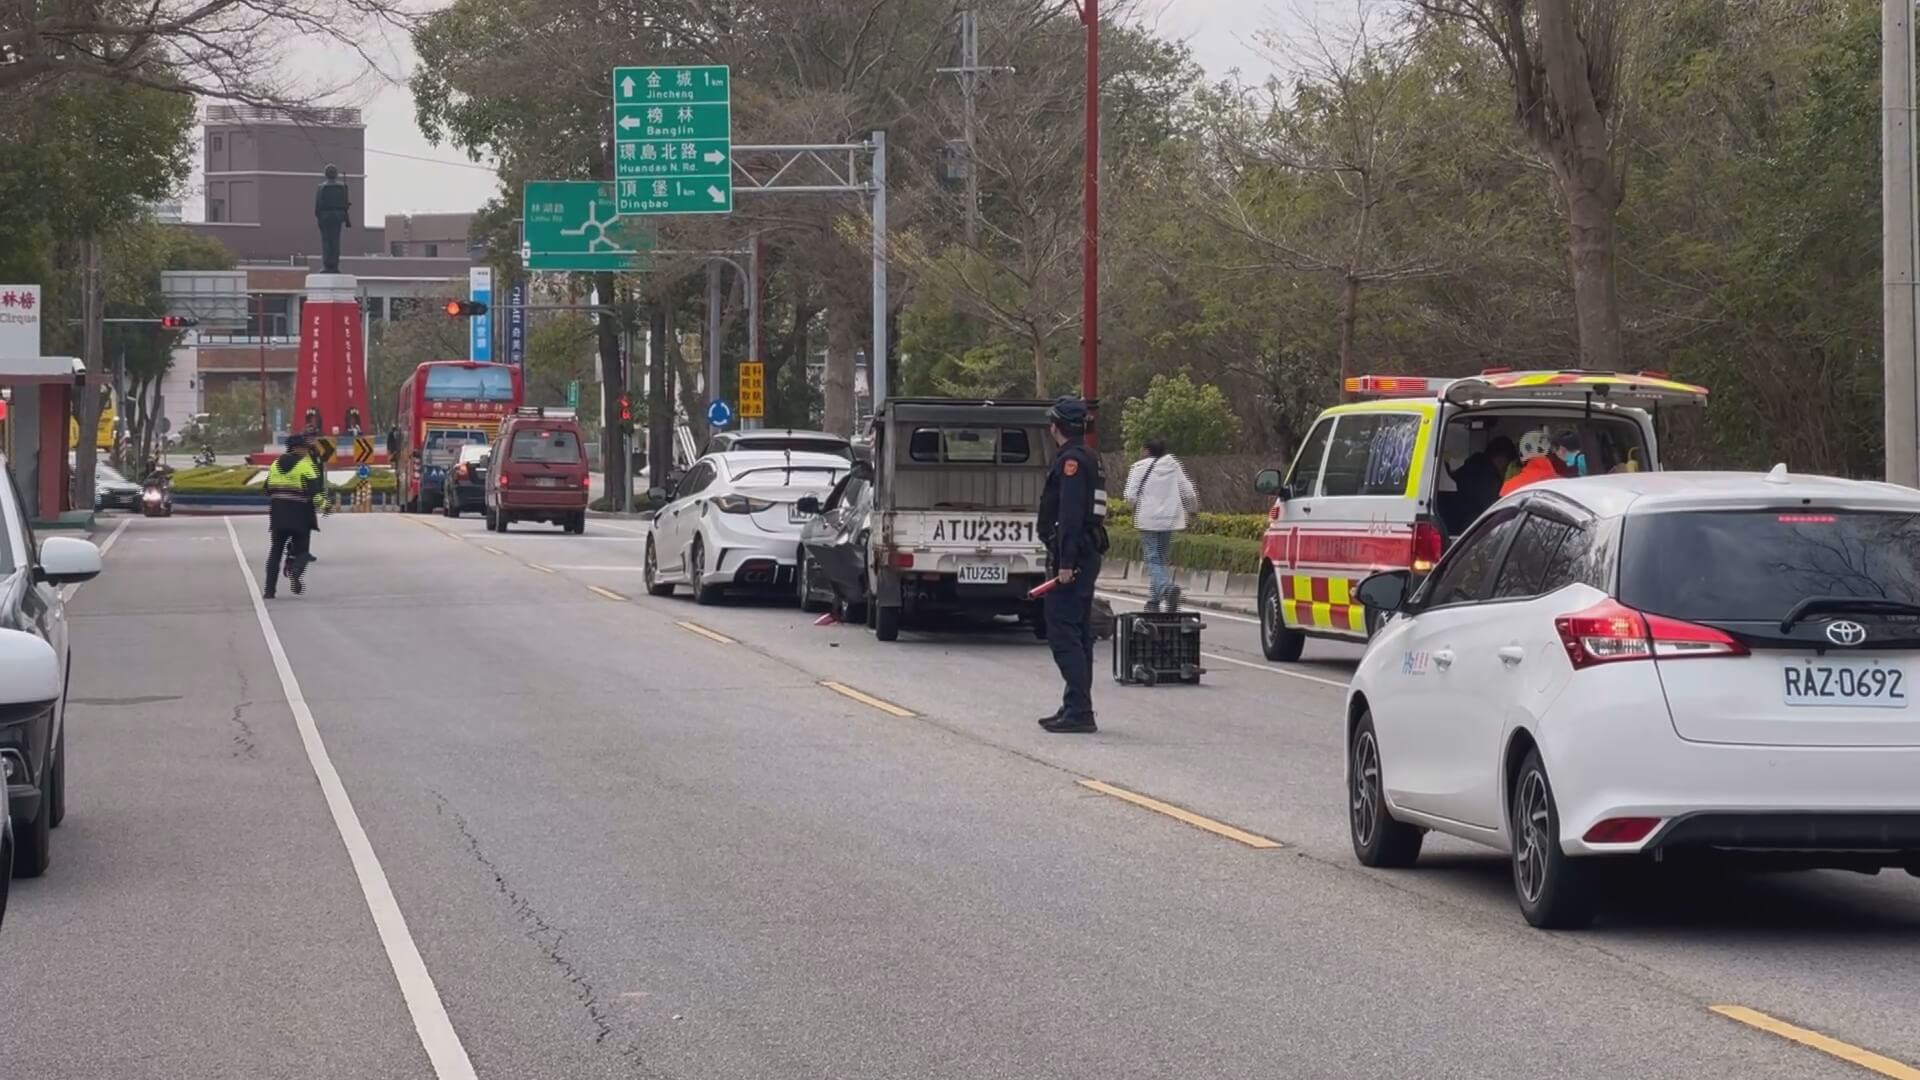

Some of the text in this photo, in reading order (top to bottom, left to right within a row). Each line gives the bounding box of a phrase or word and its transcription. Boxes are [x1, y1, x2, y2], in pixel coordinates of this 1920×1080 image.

[646, 71, 693, 88] 金城
[646, 90, 694, 100] Jincheng
[647, 106, 694, 124] 榜林
[647, 126, 694, 137] Banglin
[620, 143, 697, 160] 環島北路
[619, 163, 668, 173] Huandao
[620, 180, 668, 197] 頂堡
[620, 199, 669, 210] Dingbao
[933, 519, 1034, 542] ATU2331
